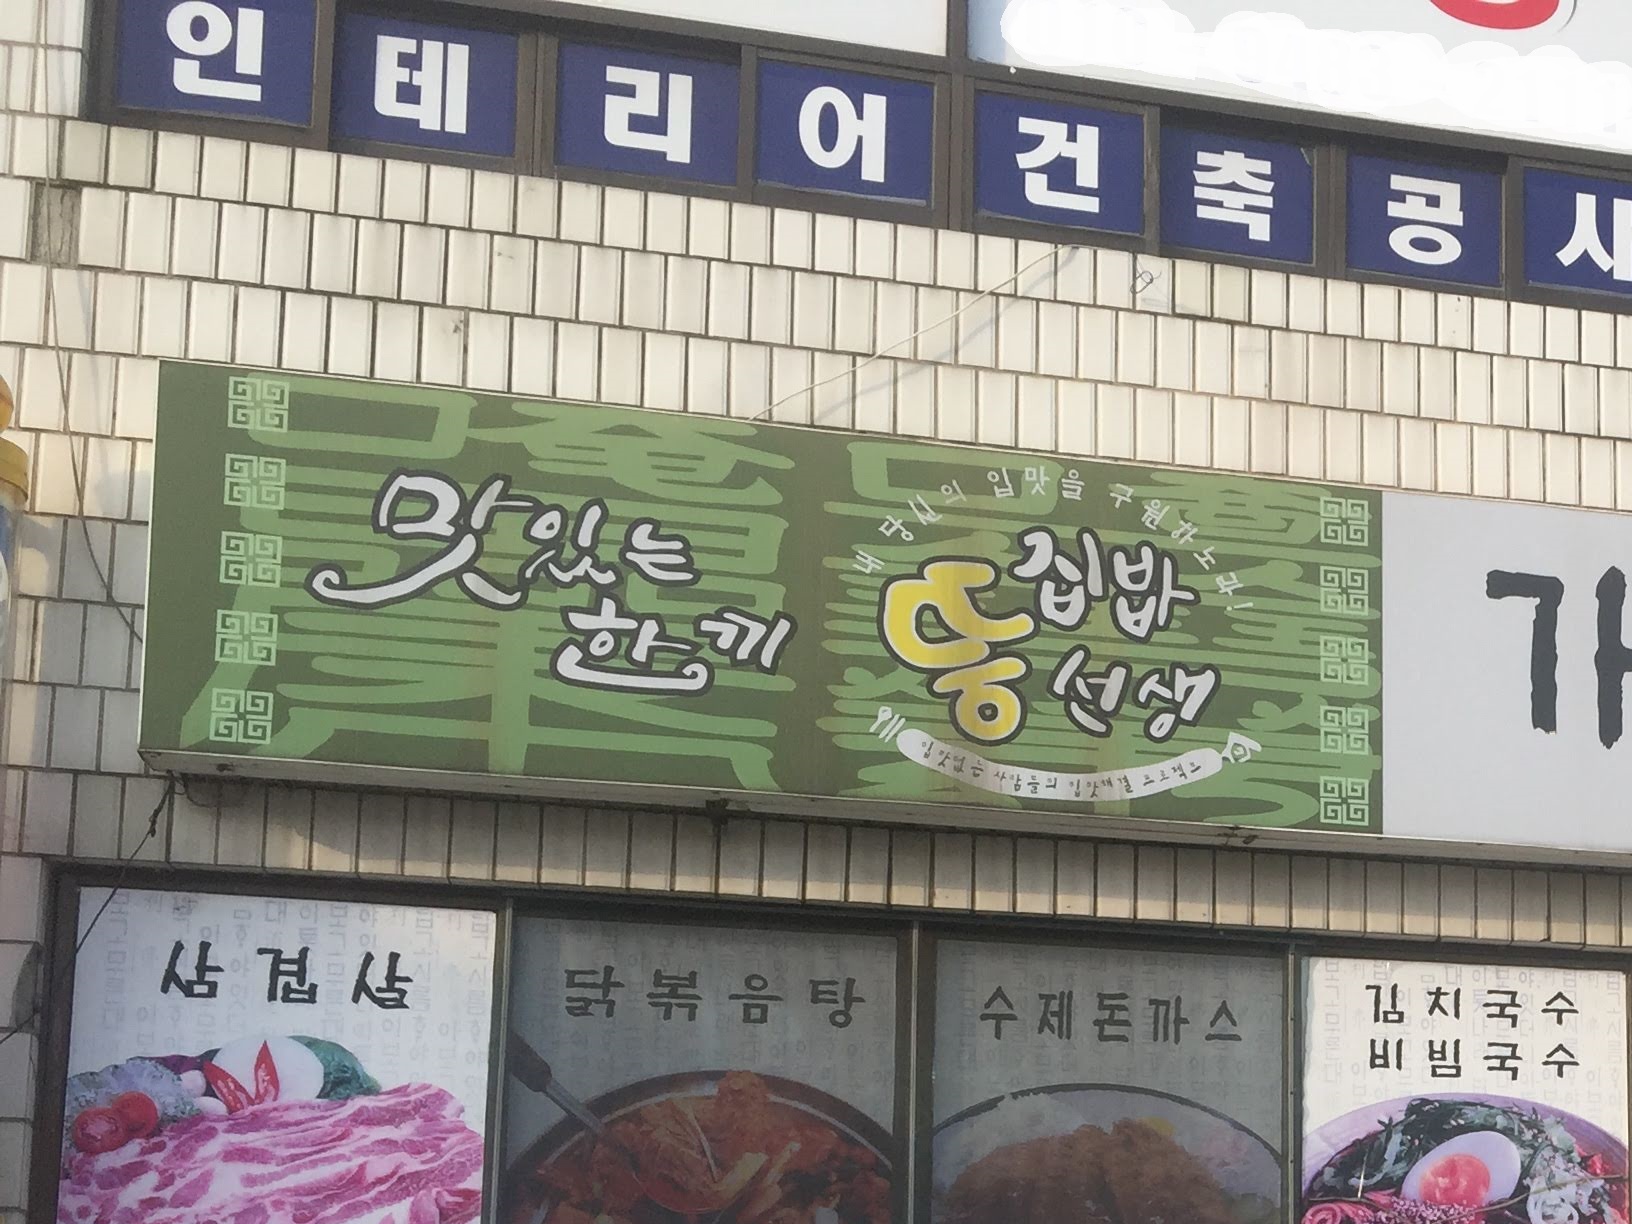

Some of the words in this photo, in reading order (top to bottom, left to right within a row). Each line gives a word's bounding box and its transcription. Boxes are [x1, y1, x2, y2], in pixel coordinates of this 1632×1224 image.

[308, 471, 700, 608] 맛있는
[1012, 528, 1198, 642] 집밥
[551, 595, 796, 692] 한끼
[159, 938, 414, 1010] 삼겹살
[562, 964, 866, 1029] 닭볶음탕
[1365, 981, 1581, 1027] 김치국수
[979, 983, 1243, 1045] 수제돈까스
[1366, 1038, 1581, 1081] 비빔국수
